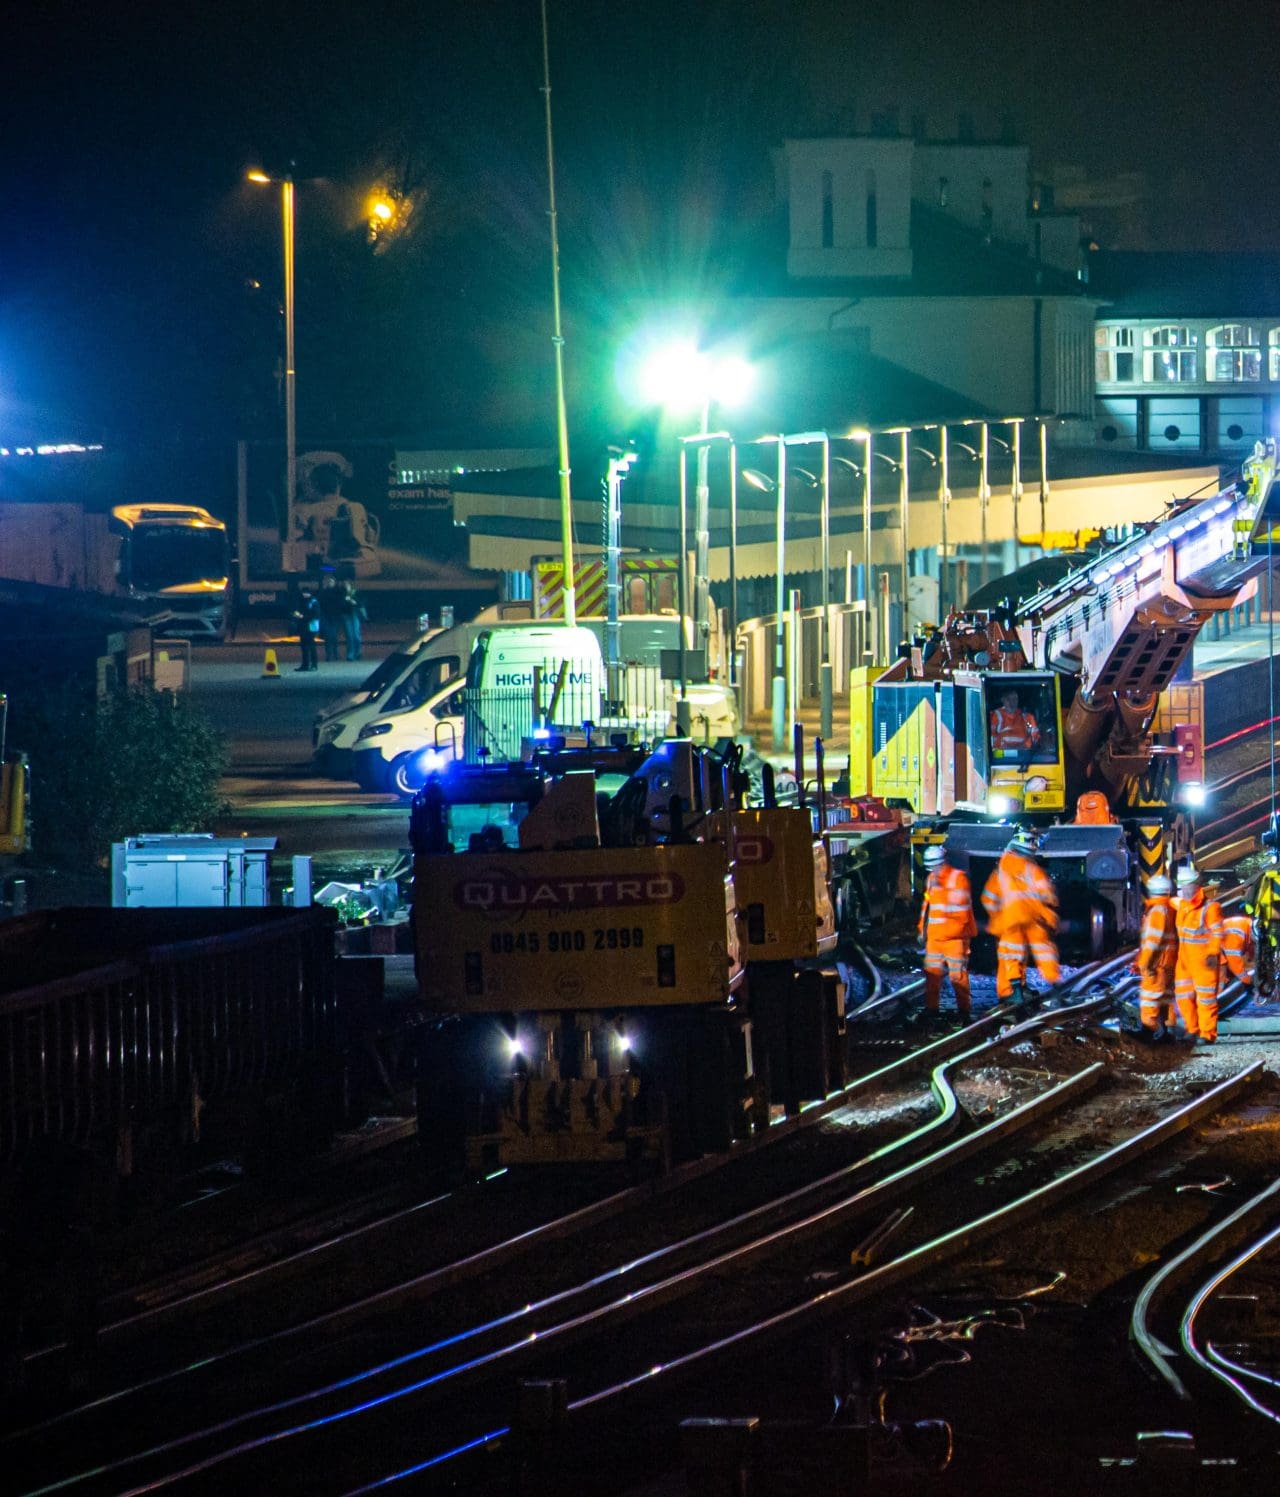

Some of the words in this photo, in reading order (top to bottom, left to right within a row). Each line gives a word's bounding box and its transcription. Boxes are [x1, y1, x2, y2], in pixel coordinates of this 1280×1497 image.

[499, 653, 505, 661] 6
[463, 879, 673, 909] QUATTRO
[491, 932, 540, 954] 0845
[548, 930, 585, 951] 900
